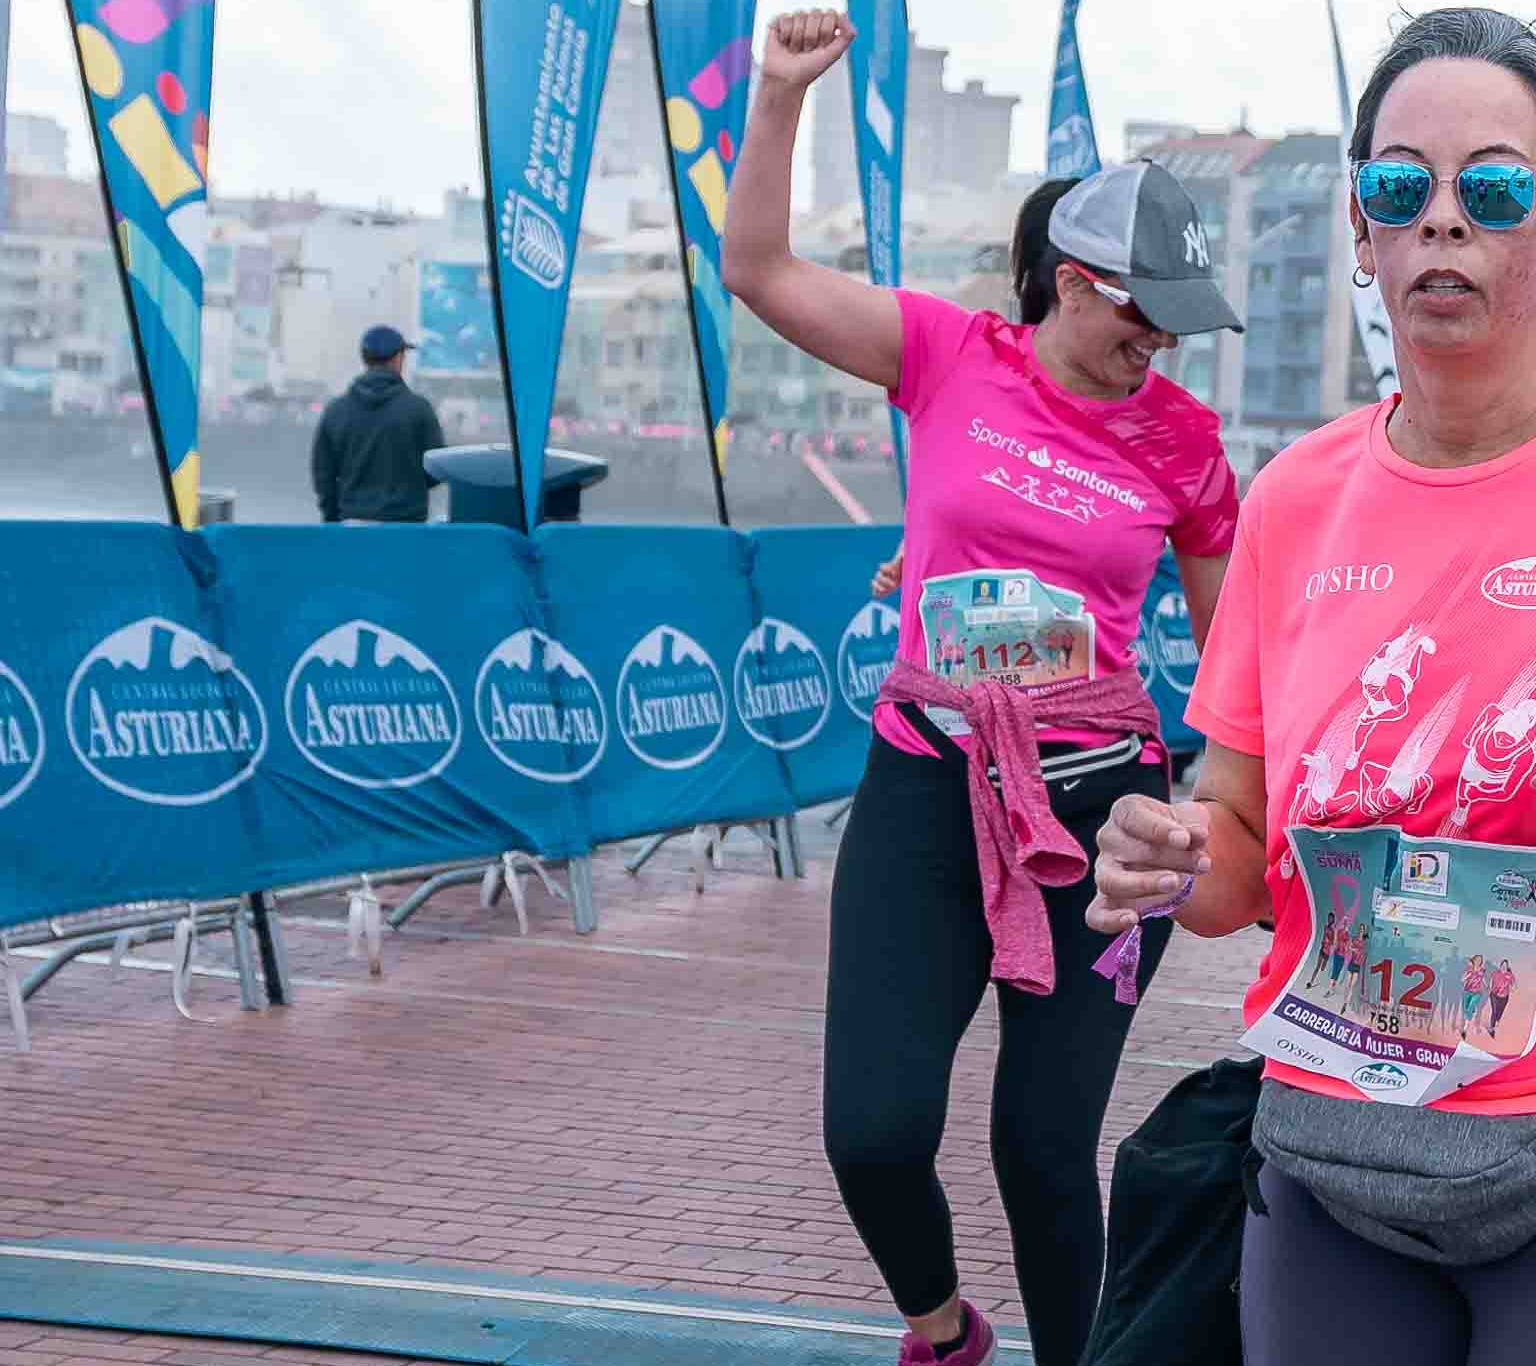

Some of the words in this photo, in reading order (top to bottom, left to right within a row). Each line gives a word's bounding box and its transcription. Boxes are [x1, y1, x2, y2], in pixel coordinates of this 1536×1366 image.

[966, 417, 1028, 461] Sports
[1054, 457, 1150, 515] Santander
[1305, 563, 1394, 601] OYSHO
[970, 641, 1037, 669] 112
[304, 681, 452, 748] ASTURIANA
[627, 682, 722, 738] ASTURIANA
[1284, 1003, 1340, 1038] CARRERA
[1337, 1026, 1351, 1042] DE
[1350, 1030, 1362, 1049] LA
